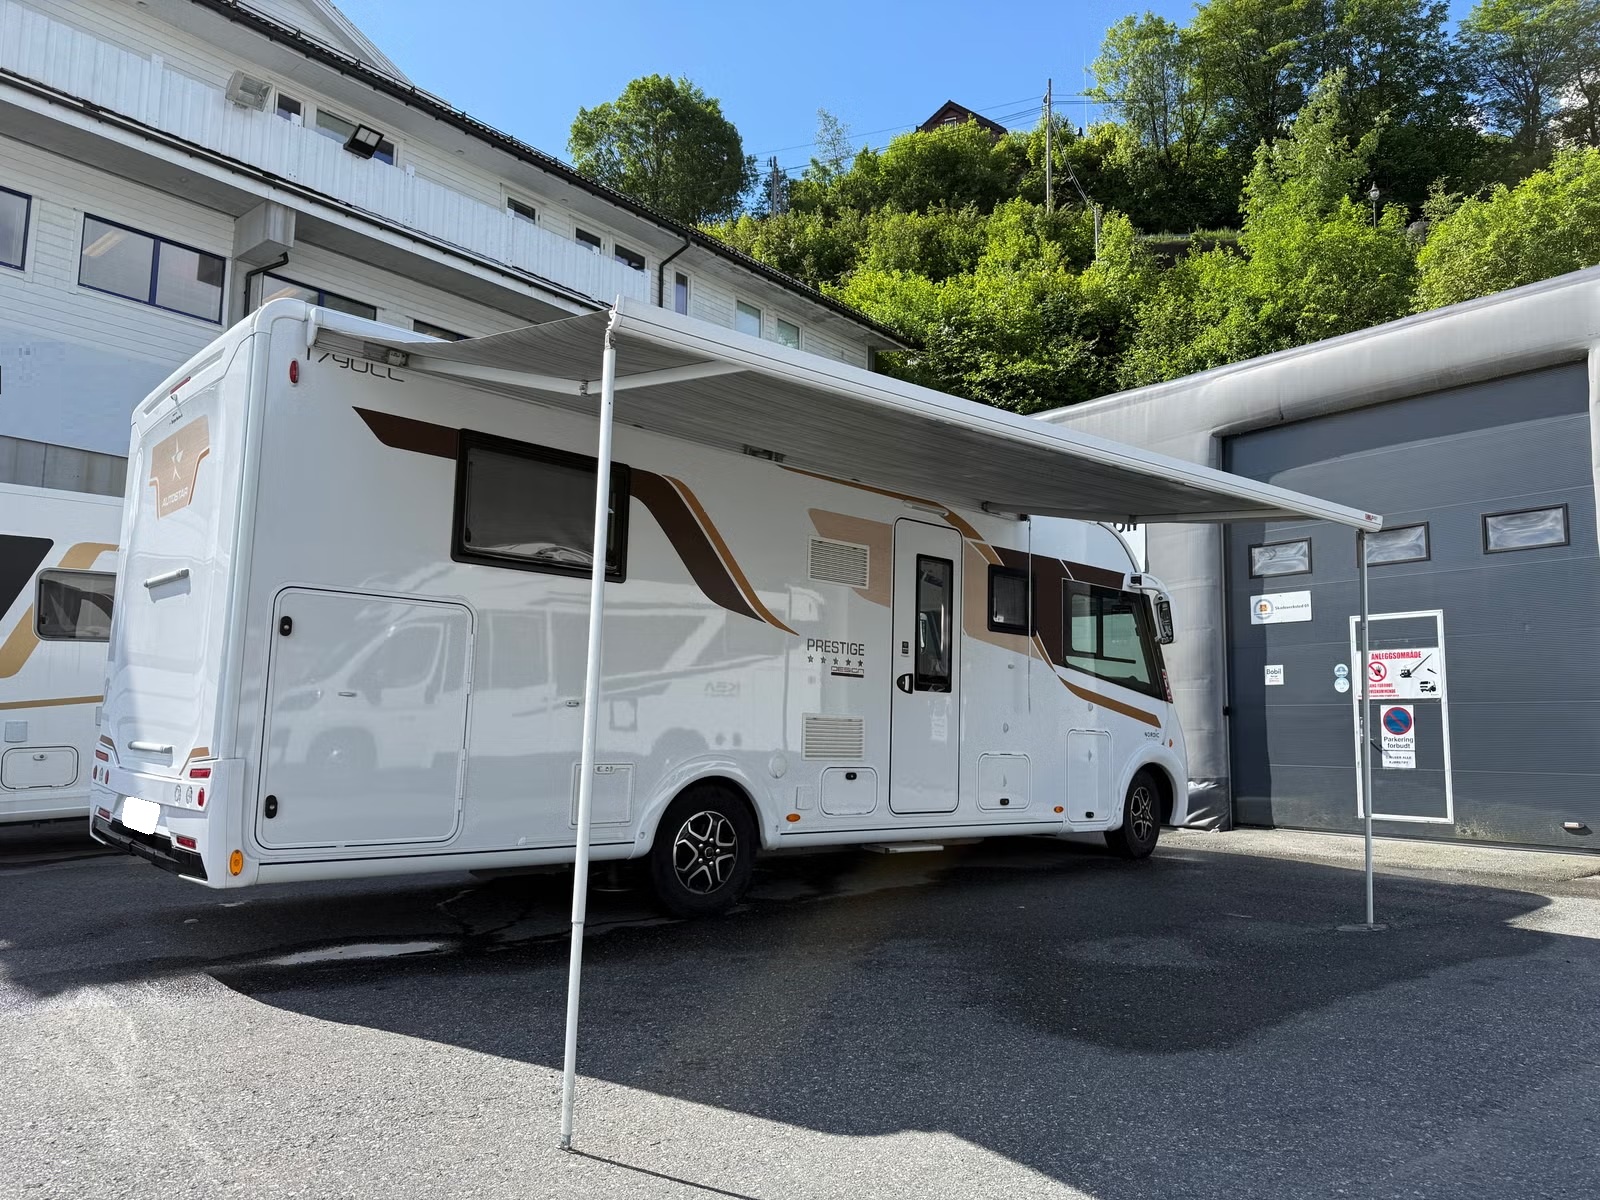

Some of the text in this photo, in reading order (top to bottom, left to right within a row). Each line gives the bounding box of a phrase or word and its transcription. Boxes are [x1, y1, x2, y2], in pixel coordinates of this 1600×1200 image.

[162, 486, 189, 507] AUTOSTAR
[806, 638, 865, 656] PRESTIGE
[1371, 650, 1422, 660] ANLEGGSOMRÅDE
